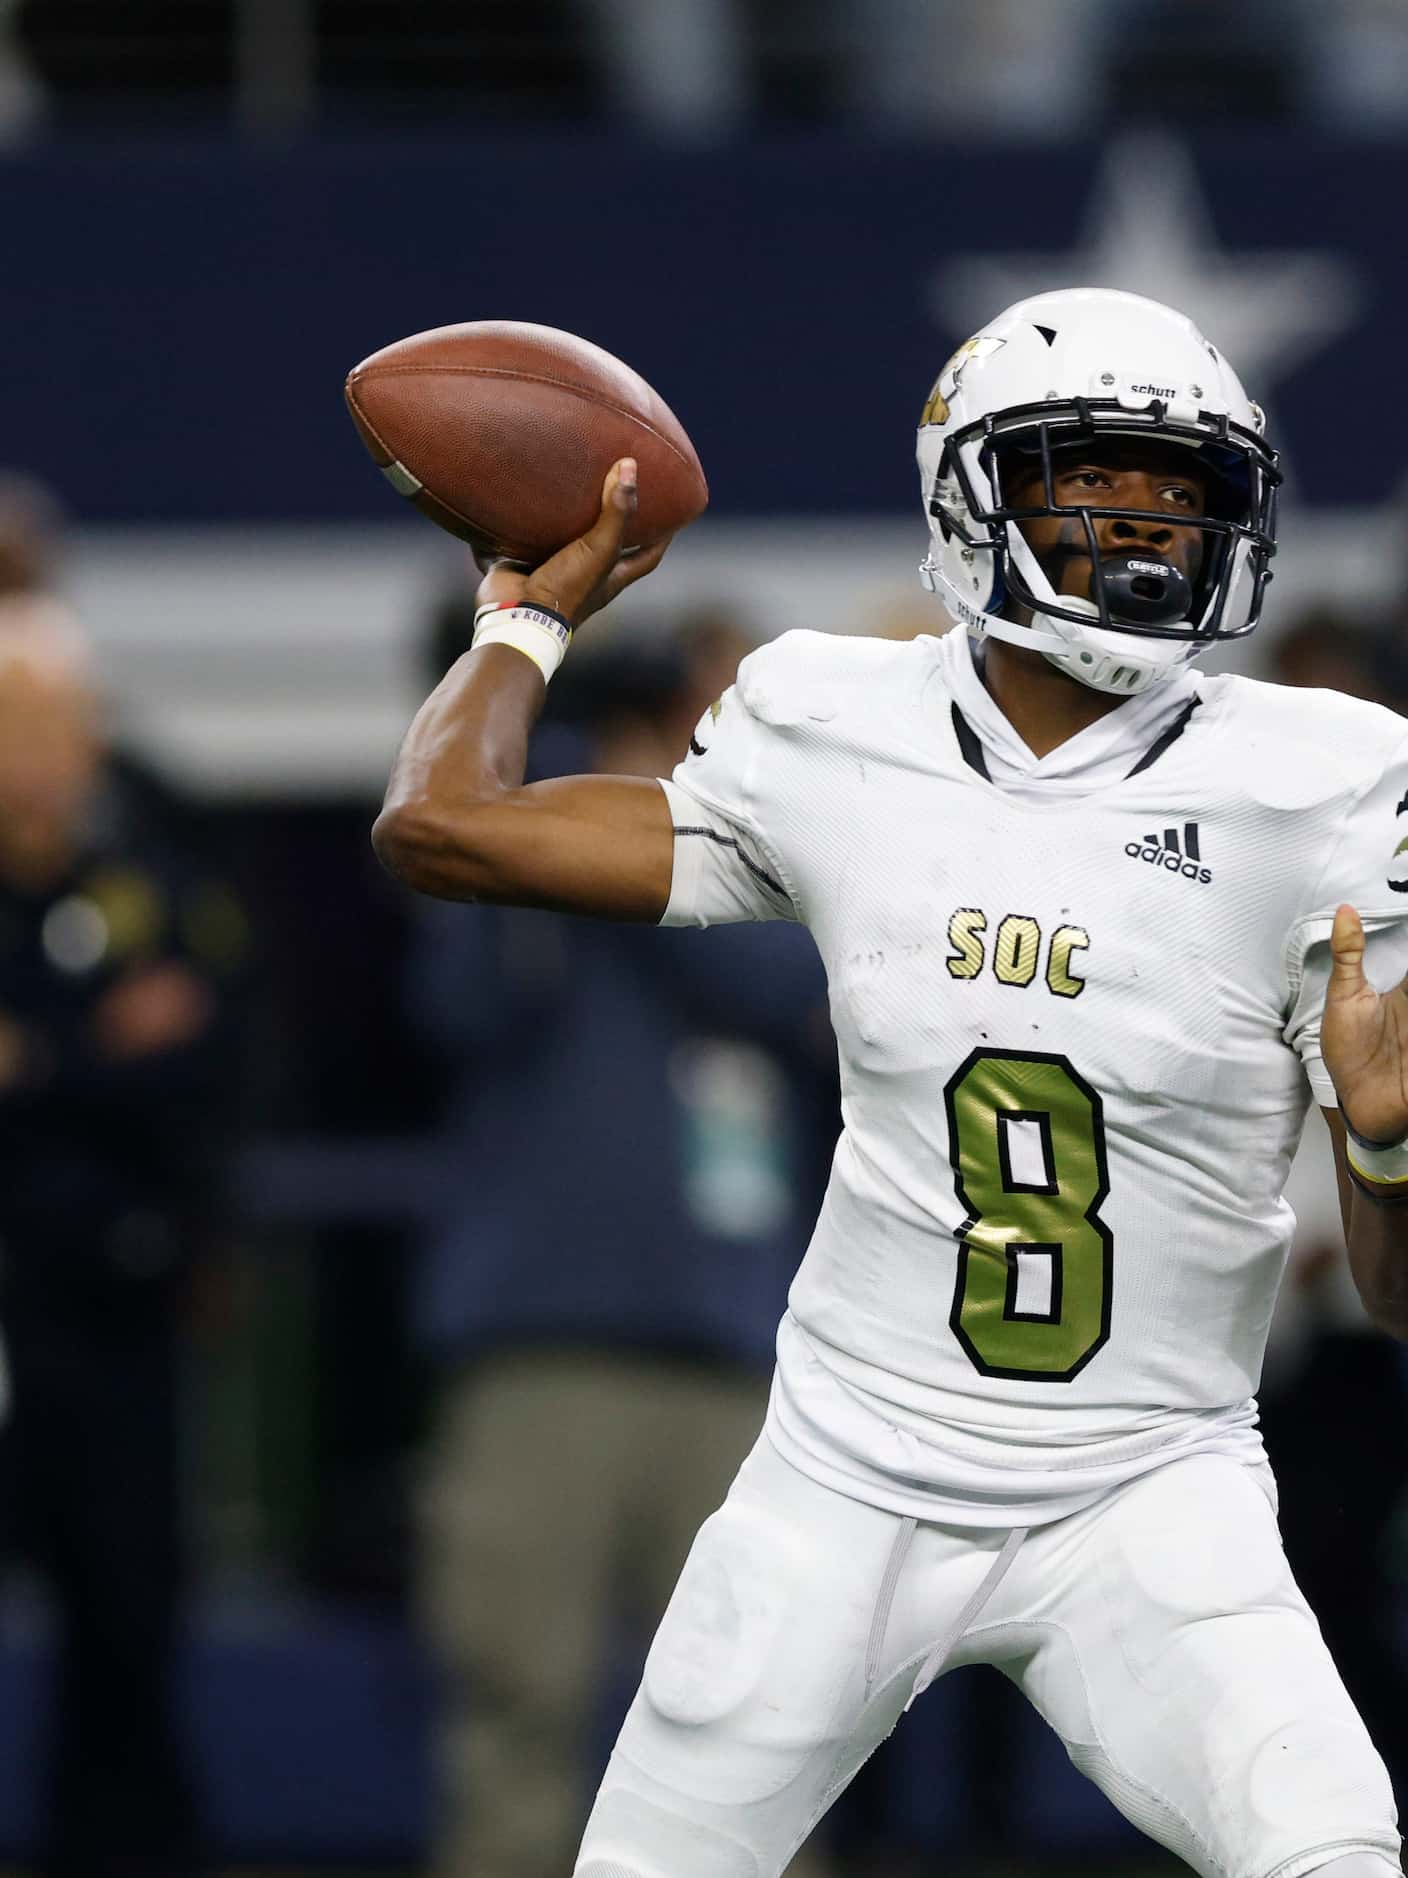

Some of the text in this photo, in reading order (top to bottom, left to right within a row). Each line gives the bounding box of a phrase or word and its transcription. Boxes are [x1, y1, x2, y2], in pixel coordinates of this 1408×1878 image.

[1130, 384, 1177, 399] schutt
[523, 609, 555, 630] KOBE
[1124, 842, 1212, 884] adidas
[945, 906, 1091, 999] SOC
[943, 1046, 1115, 1384] 8
